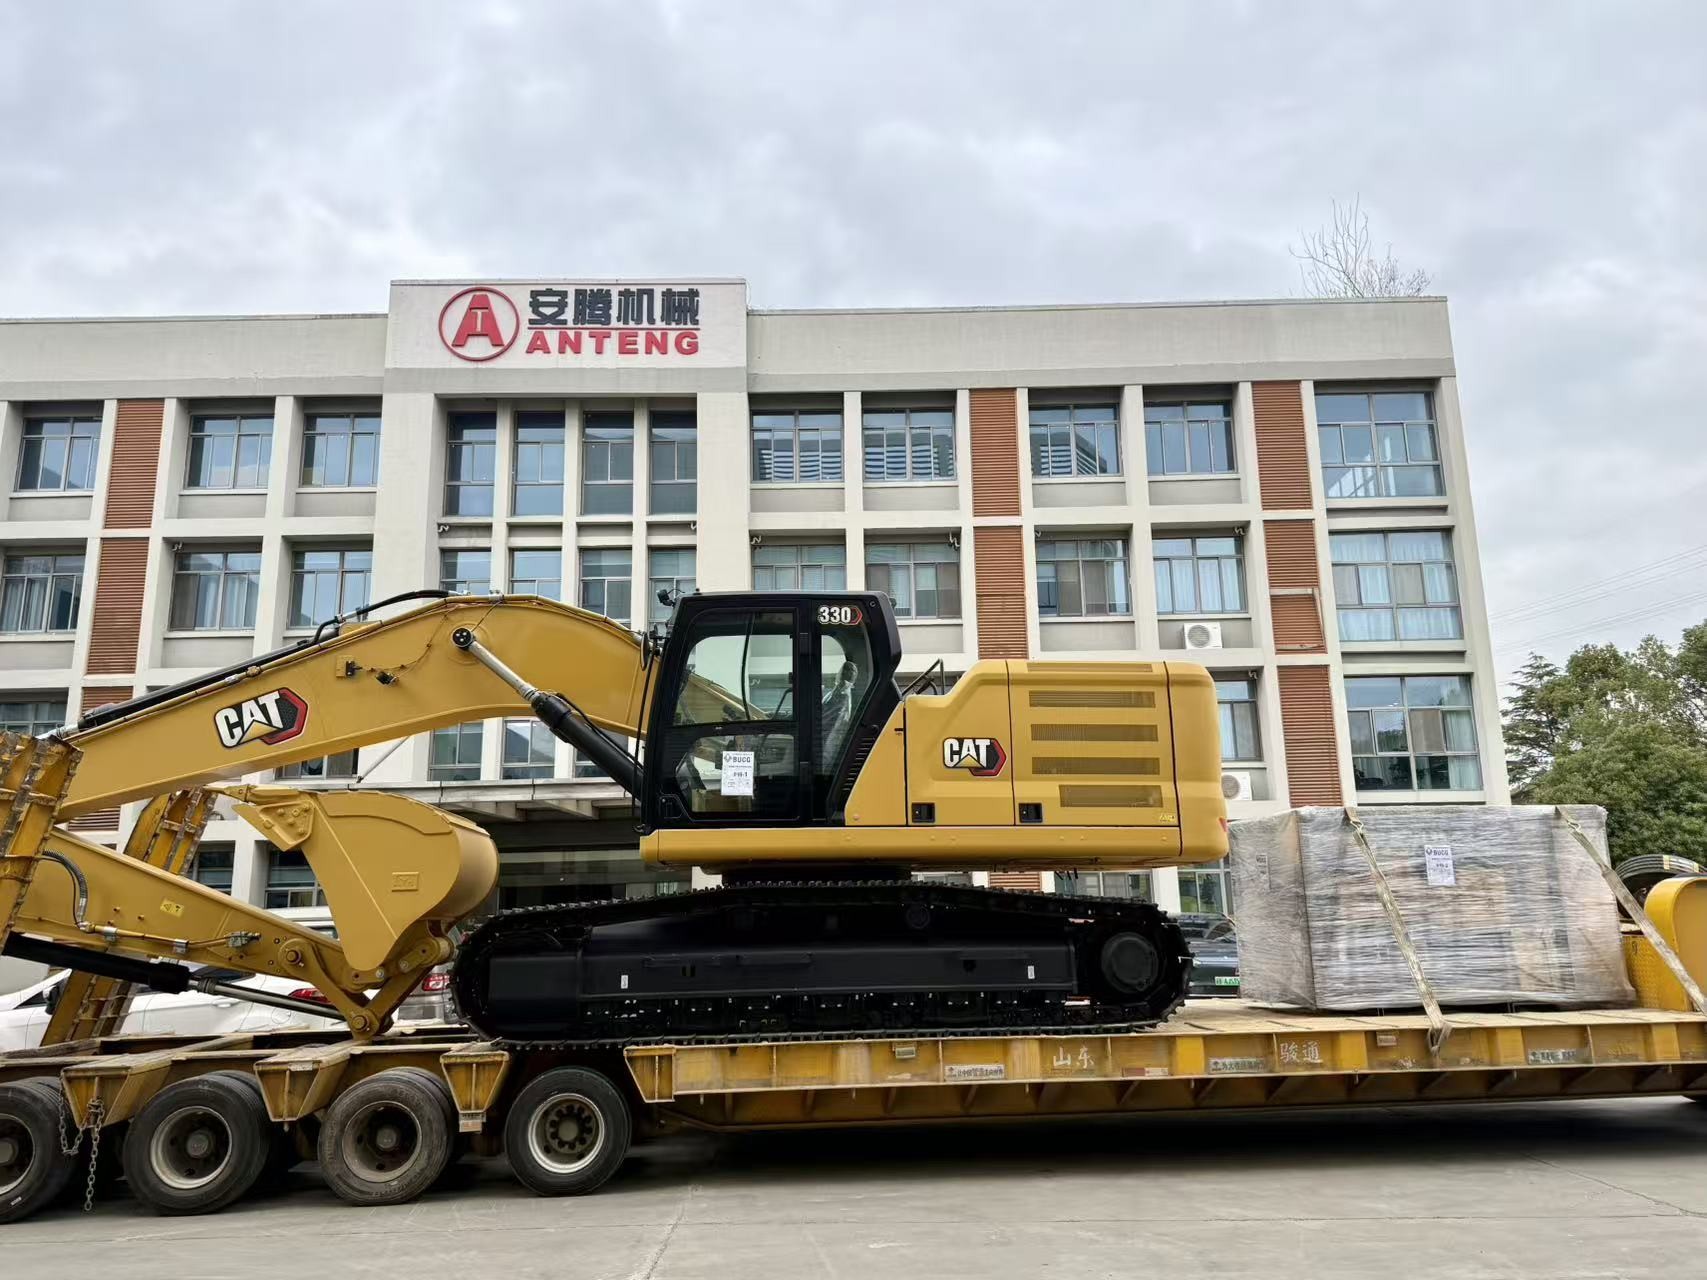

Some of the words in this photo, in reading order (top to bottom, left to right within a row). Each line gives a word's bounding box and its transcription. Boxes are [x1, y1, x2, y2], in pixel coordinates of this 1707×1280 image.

[528, 288, 700, 326] 安腾机械
[525, 331, 699, 355] ANTENG
[819, 606, 852, 623] 330
[215, 690, 283, 747] CAT
[943, 738, 991, 768] CAT
[1052, 1045, 1096, 1069] 山东
[1279, 1041, 1324, 1064] 骏通
